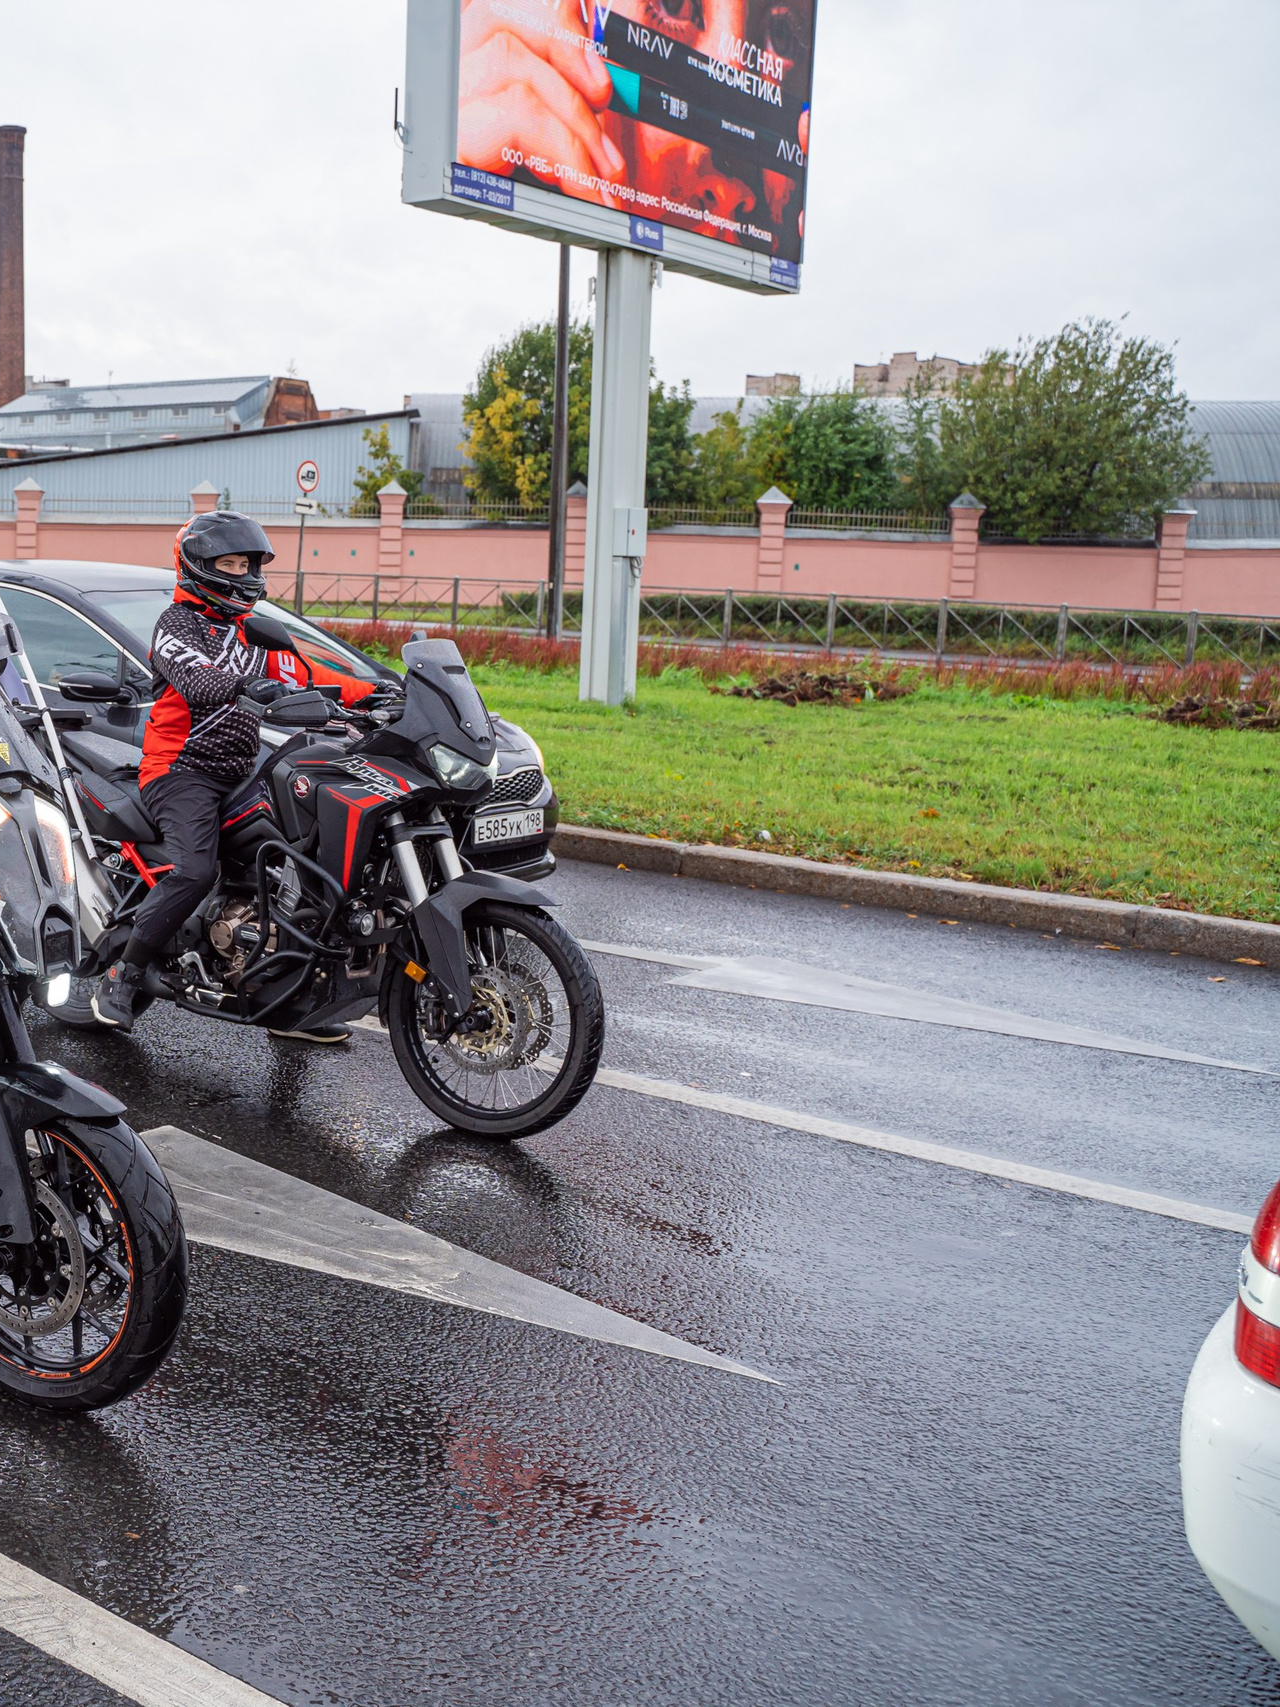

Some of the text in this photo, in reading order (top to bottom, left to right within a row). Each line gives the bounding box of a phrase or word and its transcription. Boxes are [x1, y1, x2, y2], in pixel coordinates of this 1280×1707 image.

[553, 27, 608, 58] ХАРАКТЕРОМ
[627, 23, 673, 59] NRAV
[707, 55, 783, 107] КОСМЕТИКА
[501, 147, 523, 165] ООО
[554, 164, 578, 182] ОГРН
[661, 196, 703, 220] Российская
[748, 223, 773, 242] Москва
[478, 812, 541, 841] Е585УК 198
